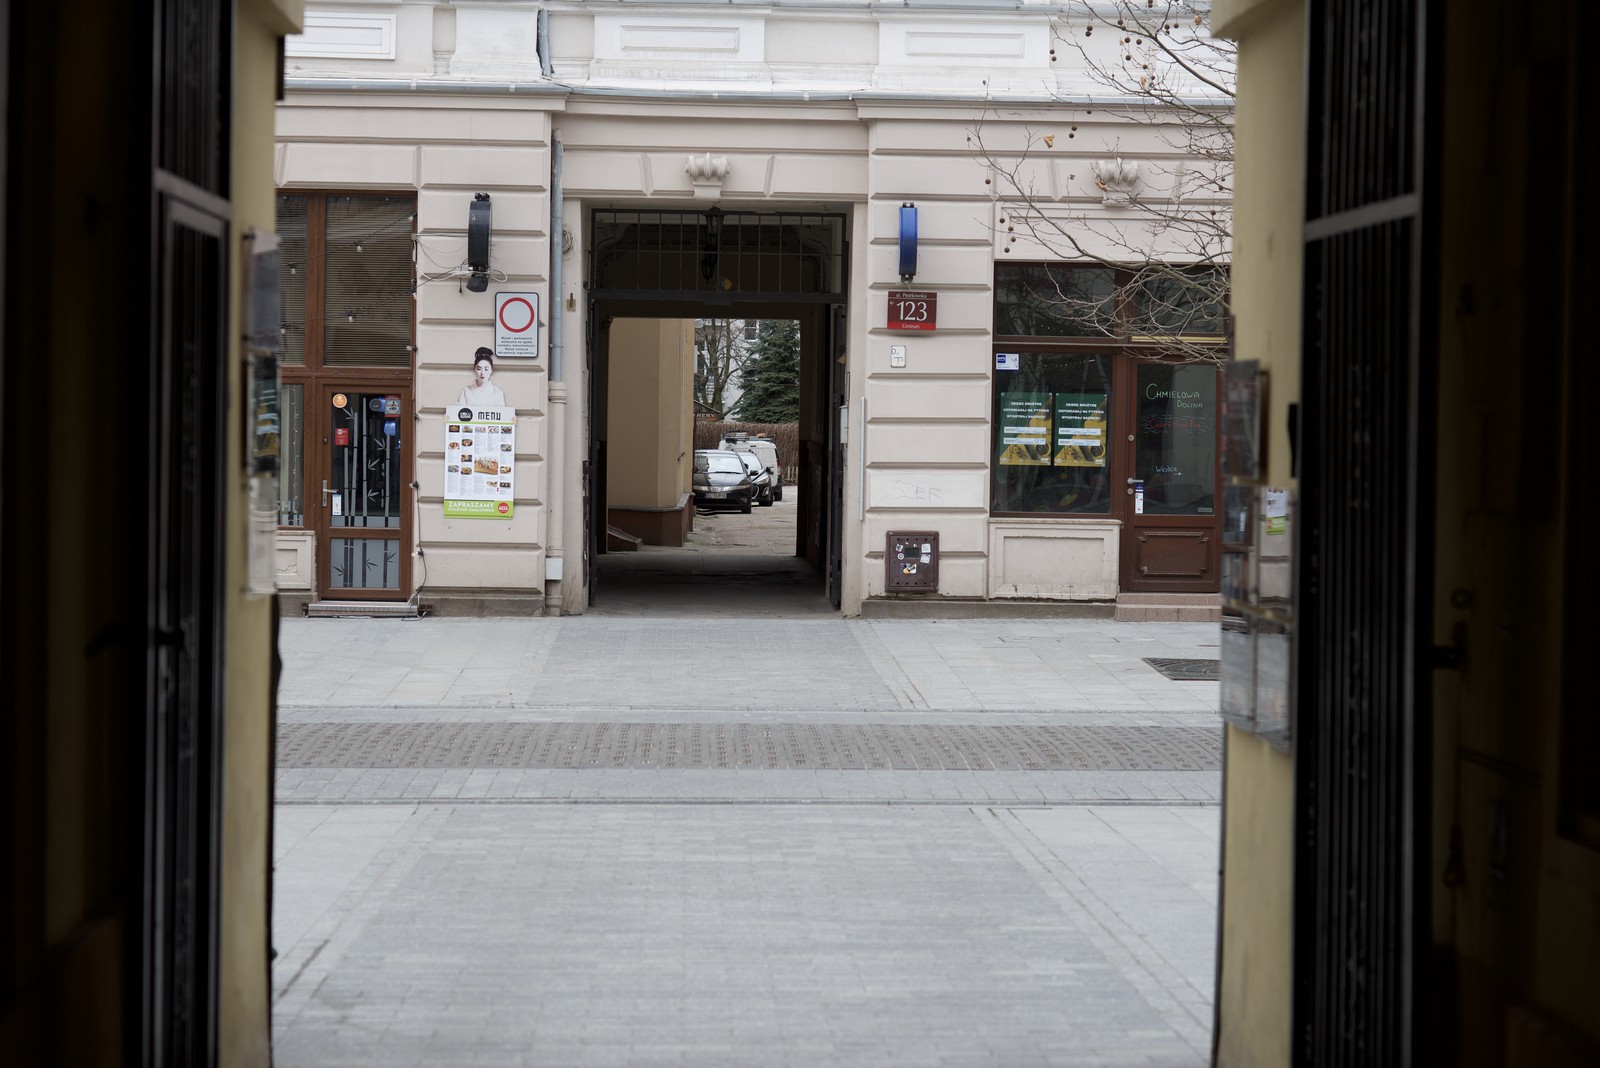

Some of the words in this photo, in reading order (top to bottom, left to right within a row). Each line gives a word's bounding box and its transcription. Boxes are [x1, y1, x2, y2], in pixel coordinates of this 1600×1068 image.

[896, 301, 928, 322] 123
[1145, 383, 1200, 400] CHMIELOWA
[1176, 400, 1203, 409] DOLINA
[477, 411, 501, 421] MENU
